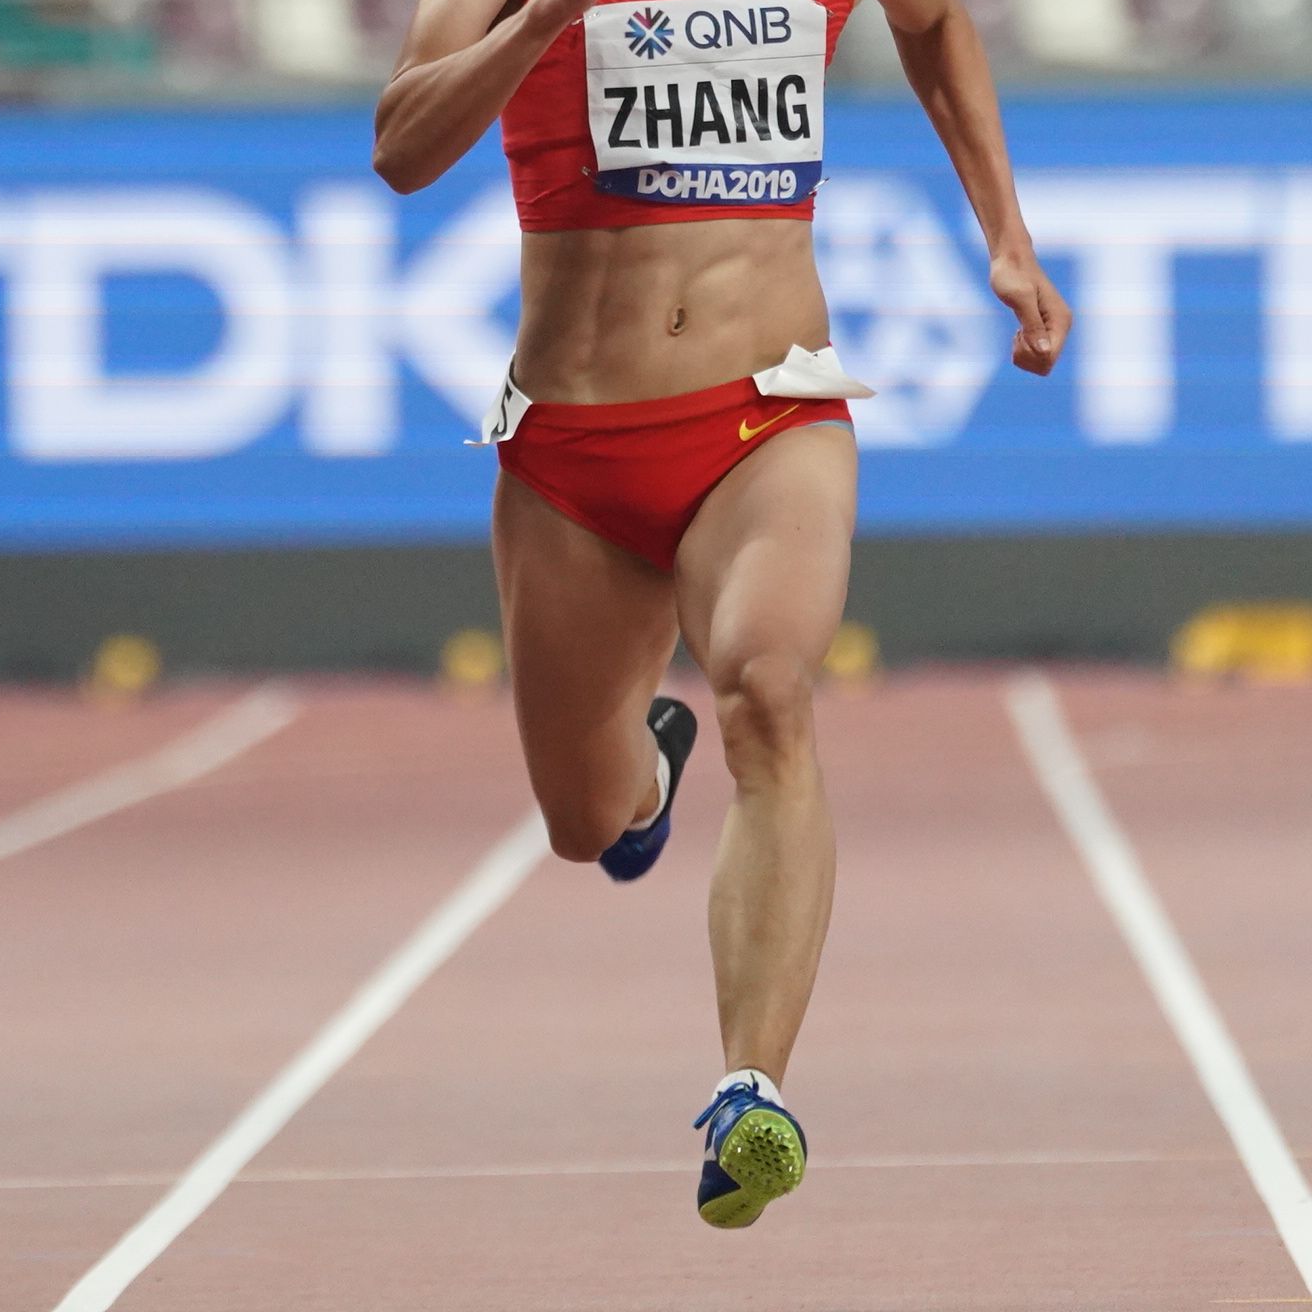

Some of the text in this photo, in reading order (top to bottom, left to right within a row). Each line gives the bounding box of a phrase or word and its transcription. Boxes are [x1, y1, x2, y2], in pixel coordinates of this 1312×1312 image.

[685, 6, 792, 49] QNB
[603, 74, 811, 149] ZHANG
[637, 168, 797, 200] DOHA2019
